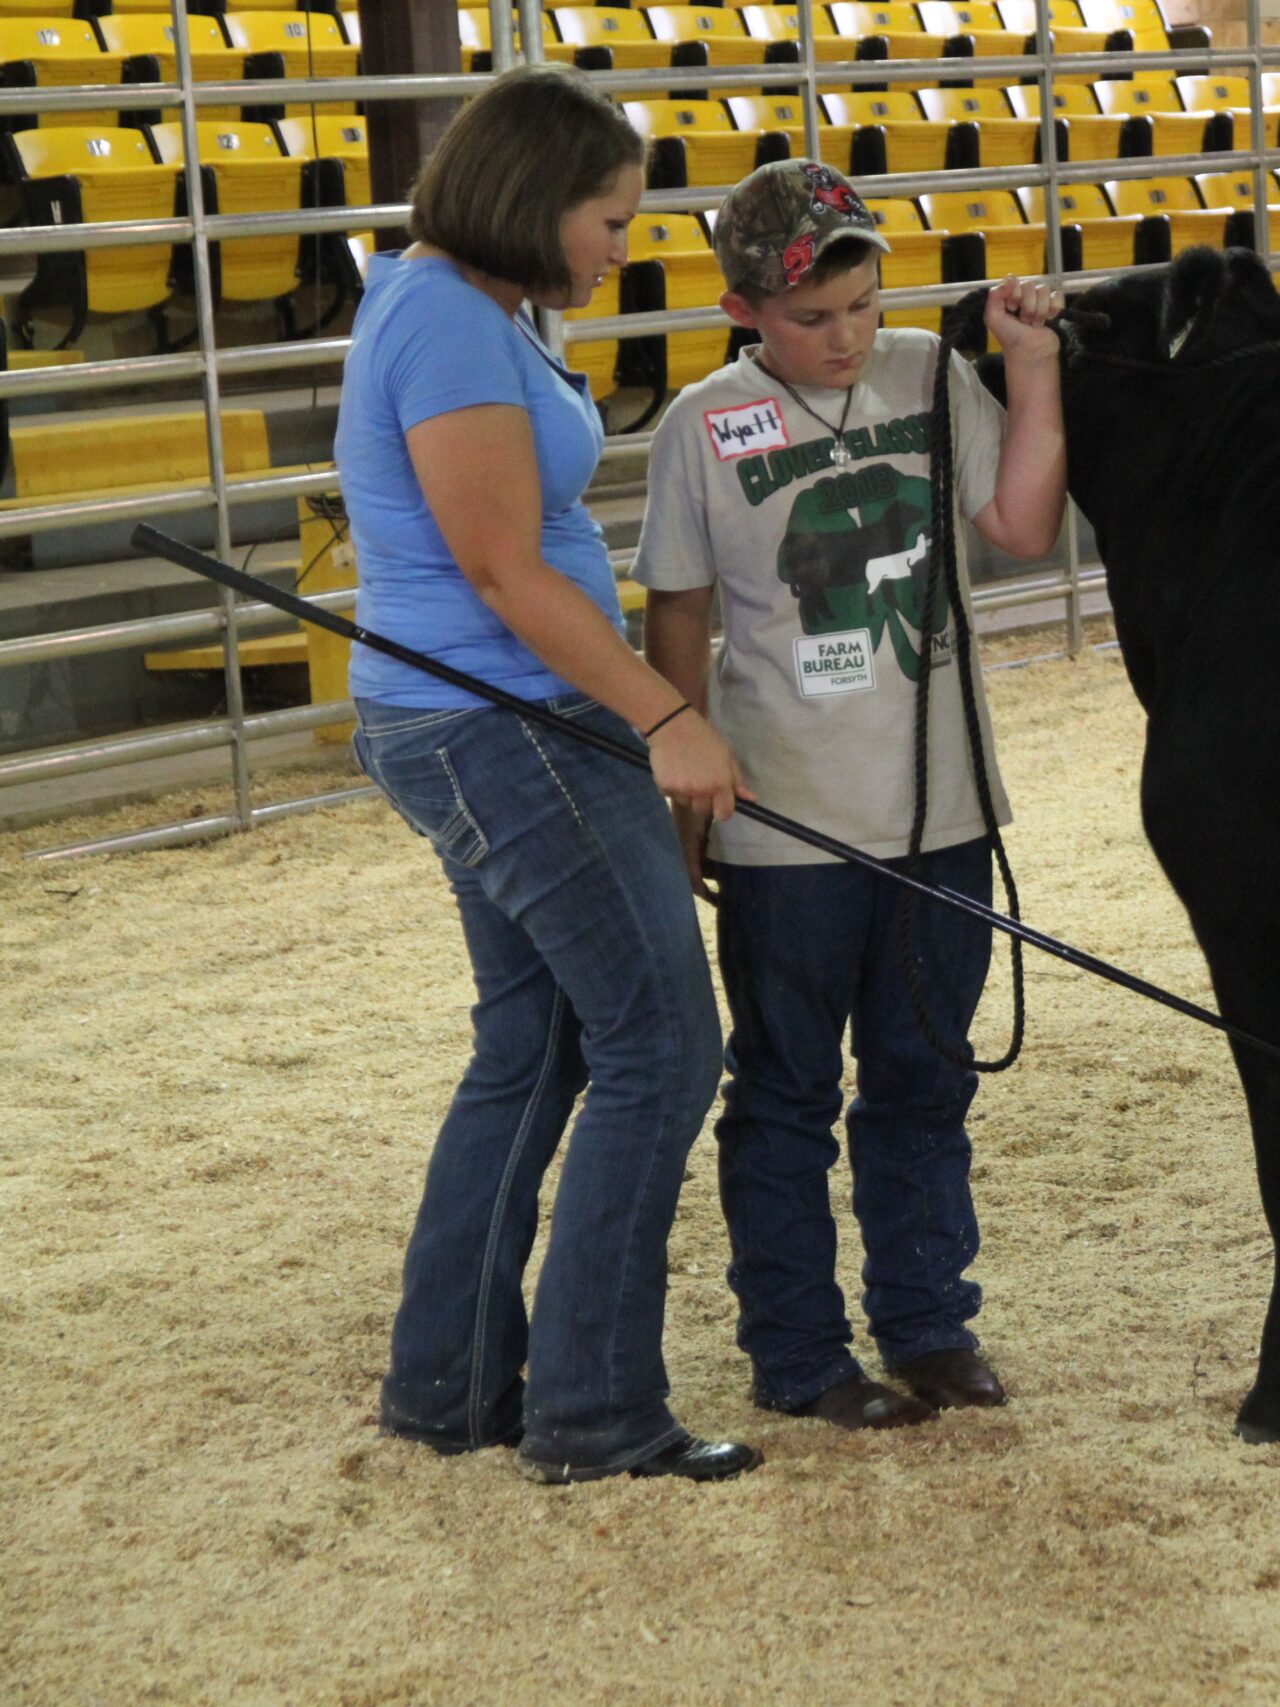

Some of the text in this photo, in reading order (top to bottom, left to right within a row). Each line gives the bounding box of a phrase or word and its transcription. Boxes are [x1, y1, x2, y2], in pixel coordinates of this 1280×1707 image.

[287, 23, 302, 37] 10
[712, 409, 779, 446] Wyatt
[737, 437, 836, 506] CLOVER
[818, 641, 862, 657] FARM
[803, 654, 865, 673] BUREAU
[830, 673, 867, 685] FORSYTH
